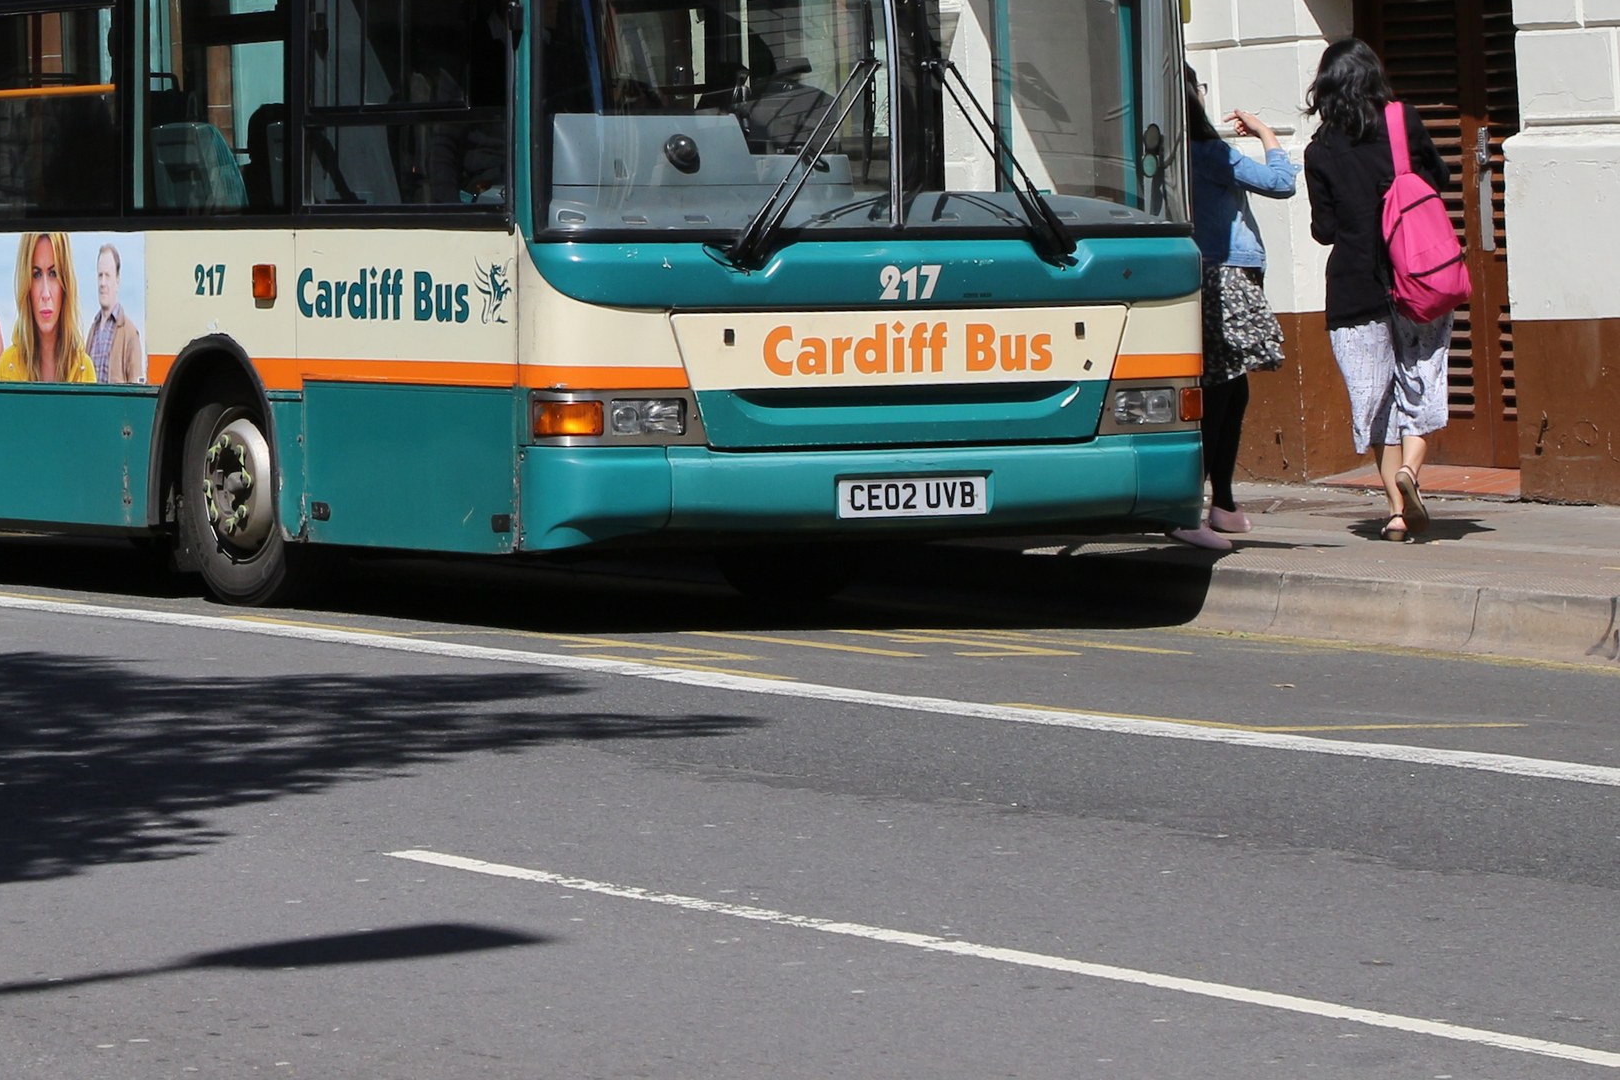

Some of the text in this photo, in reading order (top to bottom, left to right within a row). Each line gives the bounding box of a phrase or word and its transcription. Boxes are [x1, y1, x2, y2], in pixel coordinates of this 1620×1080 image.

[194, 263, 227, 297] 217
[296, 266, 470, 324] Cardiff Bus
[879, 264, 943, 301] 217
[762, 319, 1054, 377] Cardiff Bus
[849, 481, 976, 512] CE02 UVB
